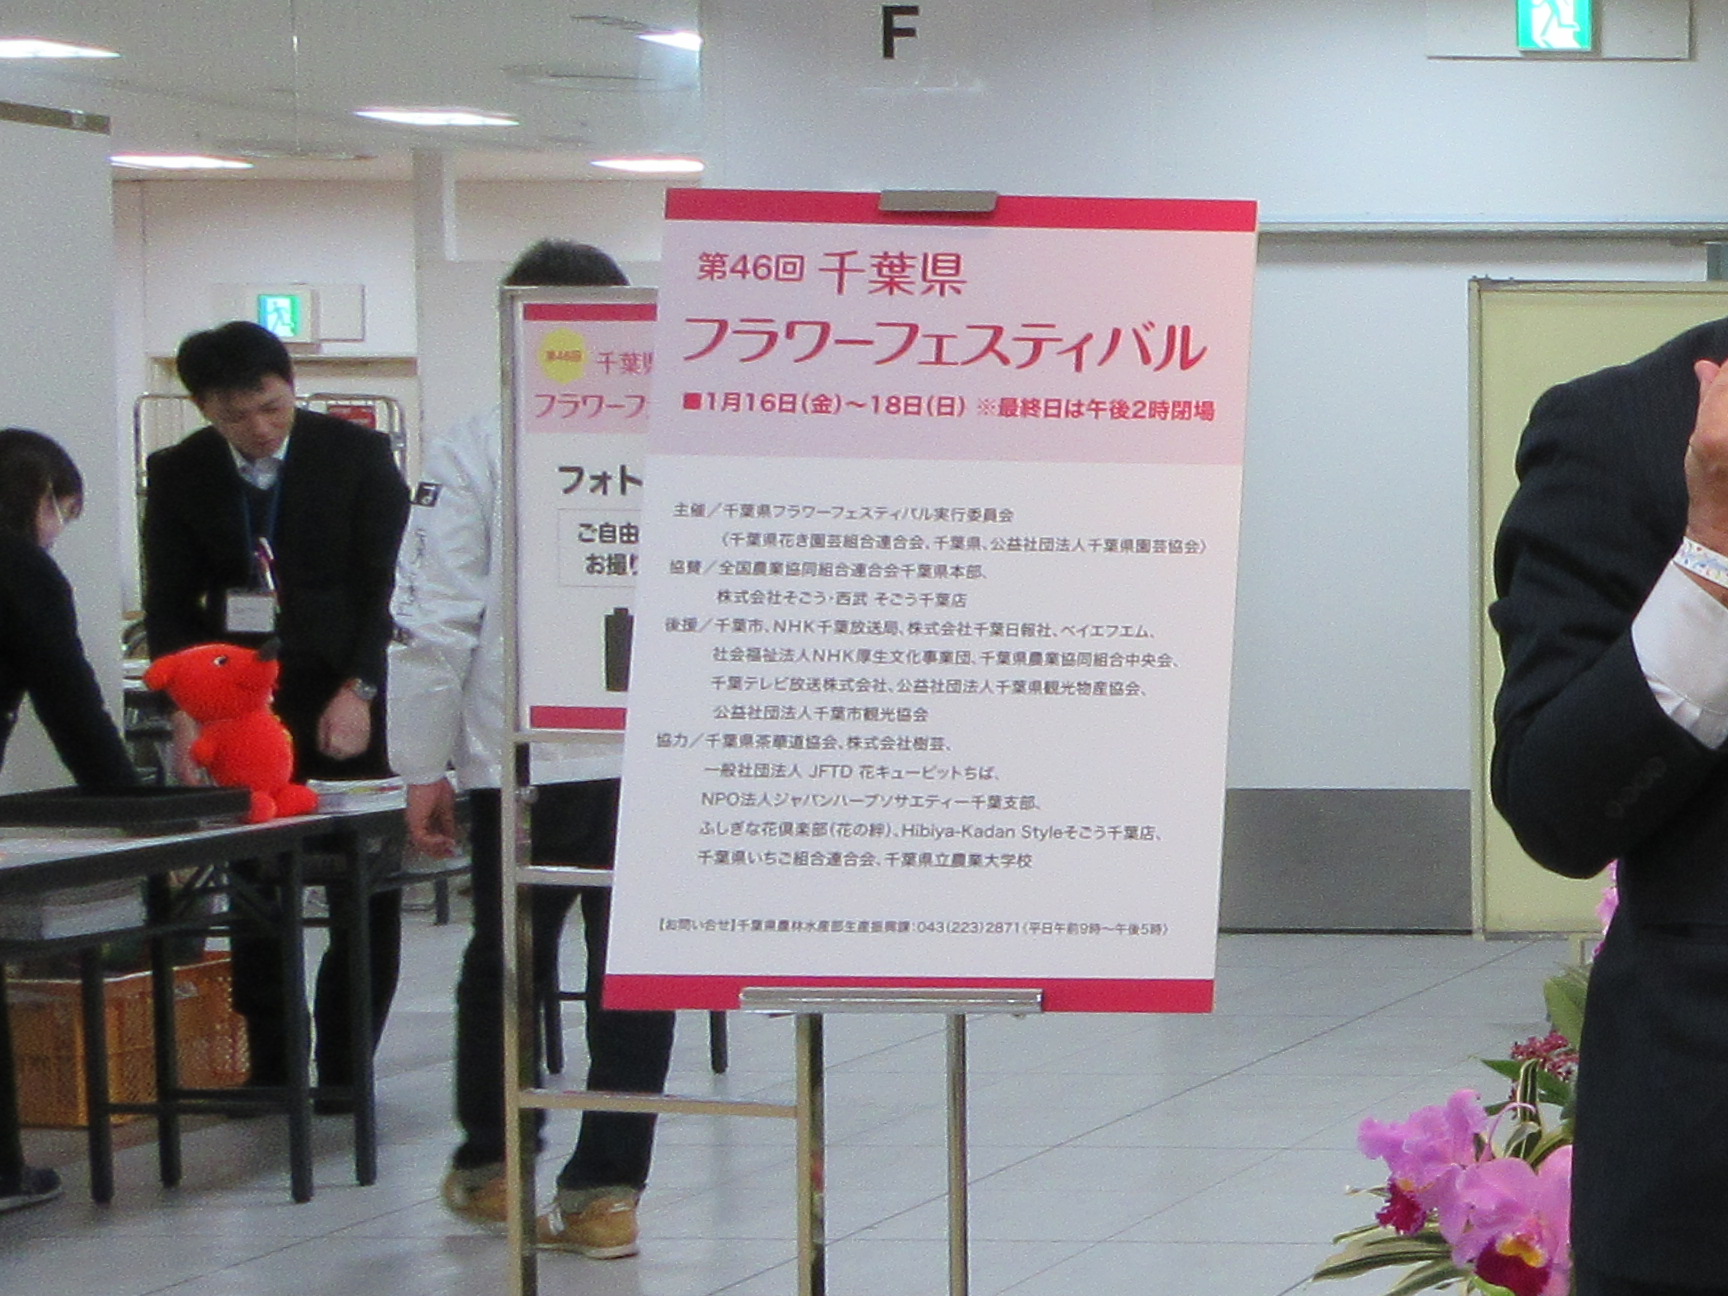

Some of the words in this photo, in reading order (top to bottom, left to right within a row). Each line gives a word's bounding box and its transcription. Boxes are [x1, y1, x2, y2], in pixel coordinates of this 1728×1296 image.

[882, 5, 920, 59] F
[697, 251, 805, 282] 第46回
[818, 250, 968, 297] 千葉県
[682, 317, 1208, 373] フラワーフェスティバル
[559, 464, 642, 495] フォト
[578, 521, 638, 544] ご自由
[704, 763, 801, 779] 一般社団法人
[808, 764, 853, 779] JFTD
